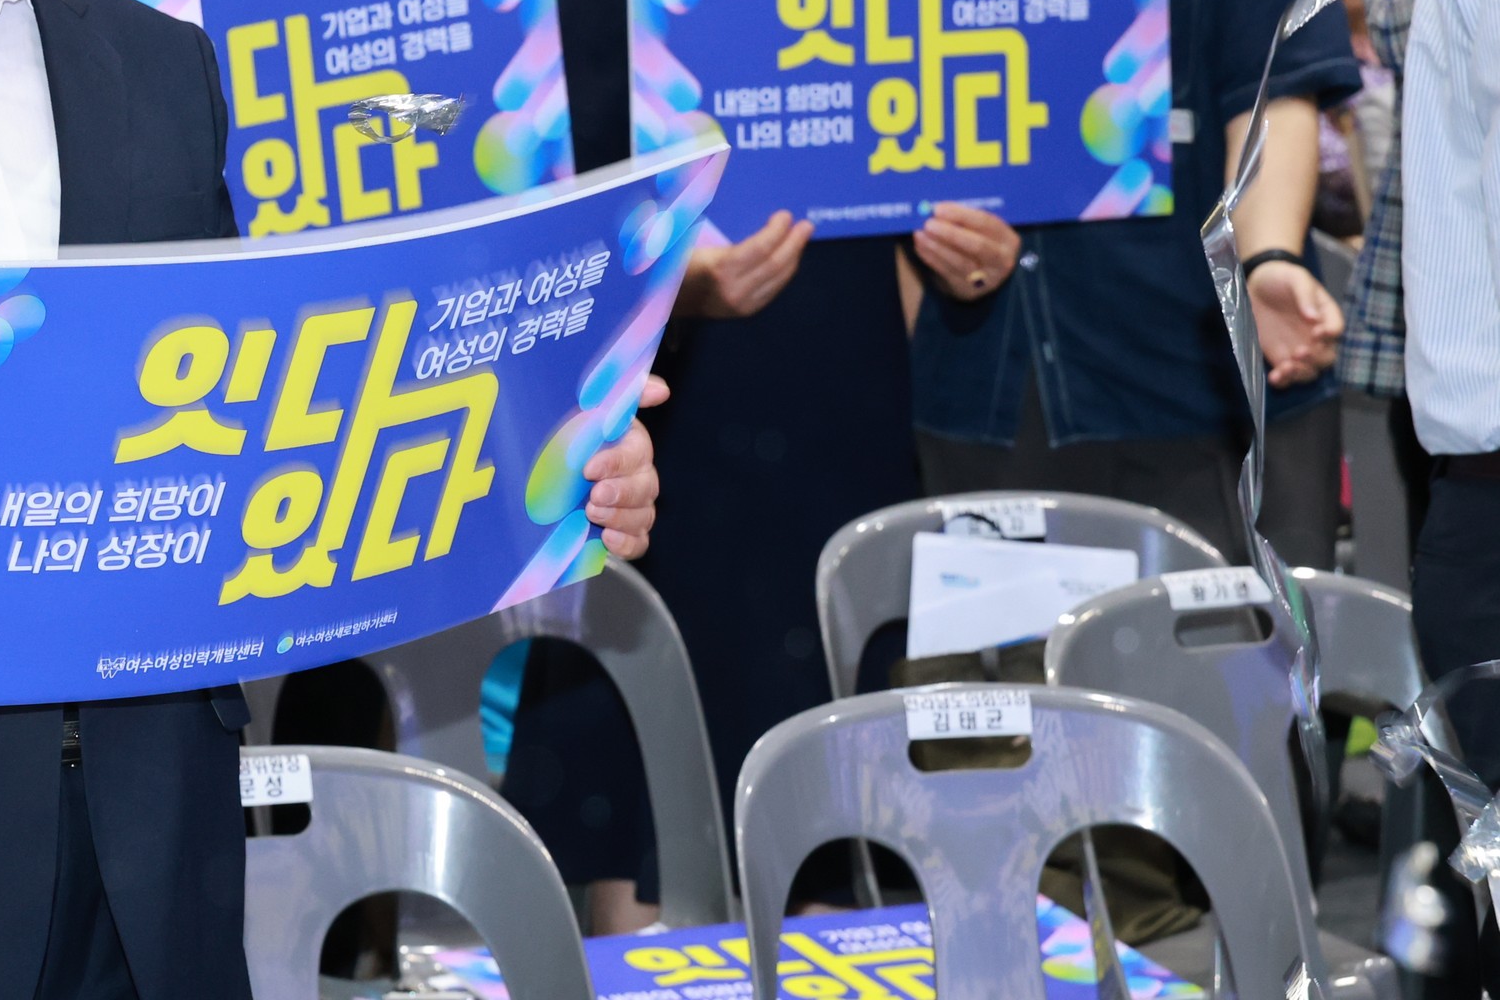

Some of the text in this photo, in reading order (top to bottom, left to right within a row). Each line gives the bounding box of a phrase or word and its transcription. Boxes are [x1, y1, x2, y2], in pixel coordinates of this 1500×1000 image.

[321, 2, 393, 40] 기업과
[226, 13, 317, 130] 다
[325, 21, 473, 75] 여성의 경력을
[714, 81, 854, 118] 내일의 희망이
[867, 45, 1049, 175] 있다
[736, 116, 854, 150] 나의 성장이
[430, 248, 612, 333] 기업과 여성을
[414, 297, 596, 382] 여성의 경력을
[114, 299, 419, 464] 잇다
[108, 480, 227, 521] 희망이
[217, 400, 500, 607] 있다
[7, 530, 211, 575] 나의 성장이
[295, 612, 398, 648] 여수여성새로일하기센터
[125, 642, 265, 675] 여수여성인력개발센터
